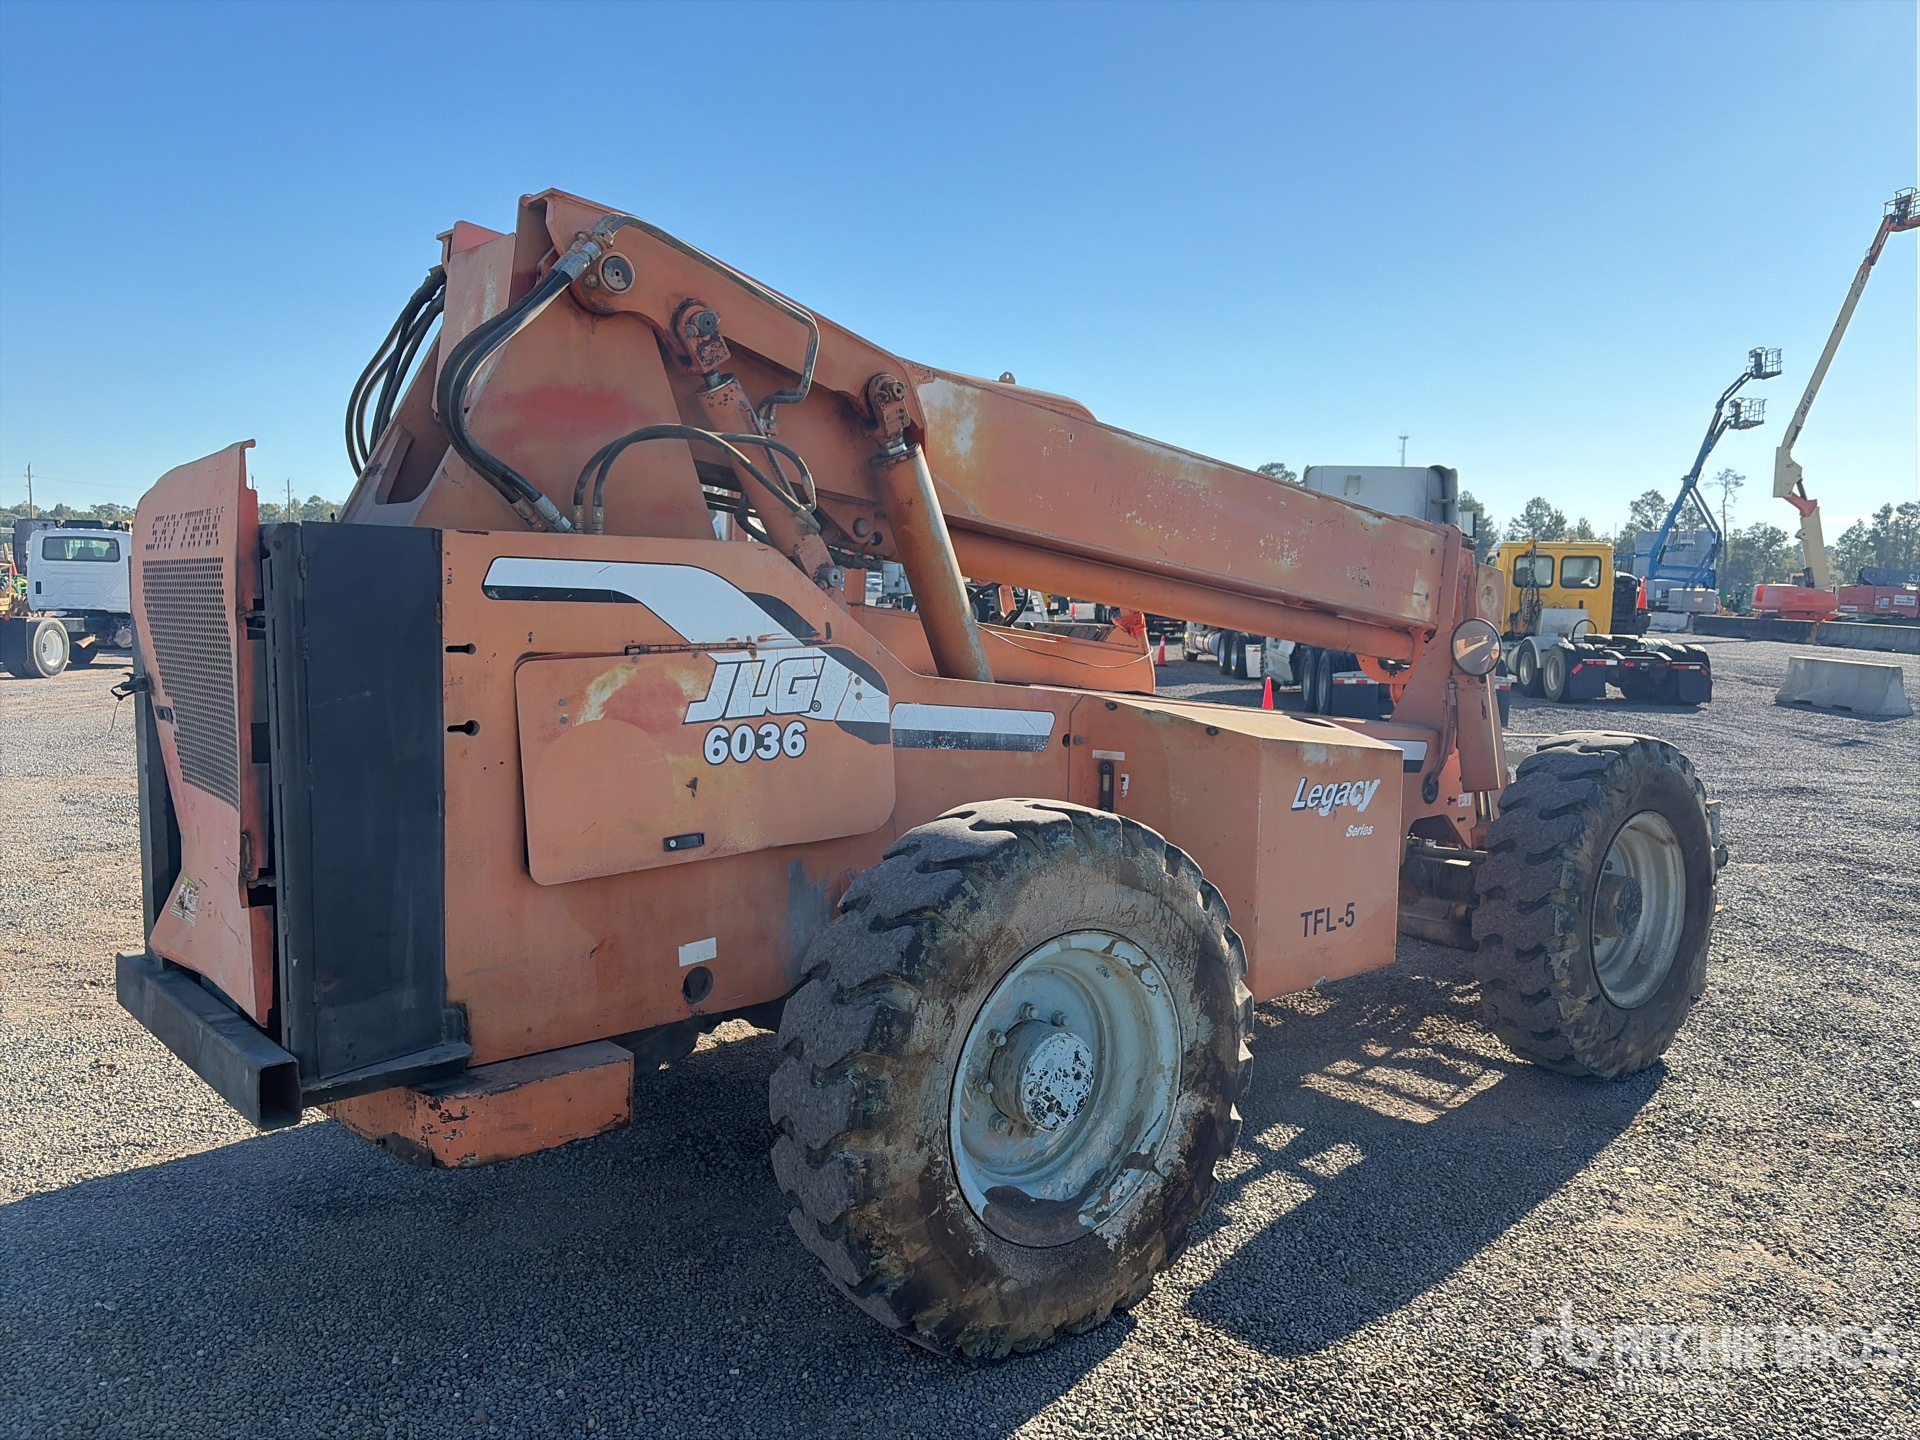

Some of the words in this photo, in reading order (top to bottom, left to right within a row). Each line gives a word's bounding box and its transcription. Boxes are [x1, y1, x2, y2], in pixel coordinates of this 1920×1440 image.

[1908, 573, 1920, 583] SJ
[682, 656, 826, 724] JLG
[703, 720, 808, 765] 6036
[1291, 777, 1381, 817] Legacy
[1346, 823, 1374, 838] Series
[1300, 902, 1355, 938] TFL-5
